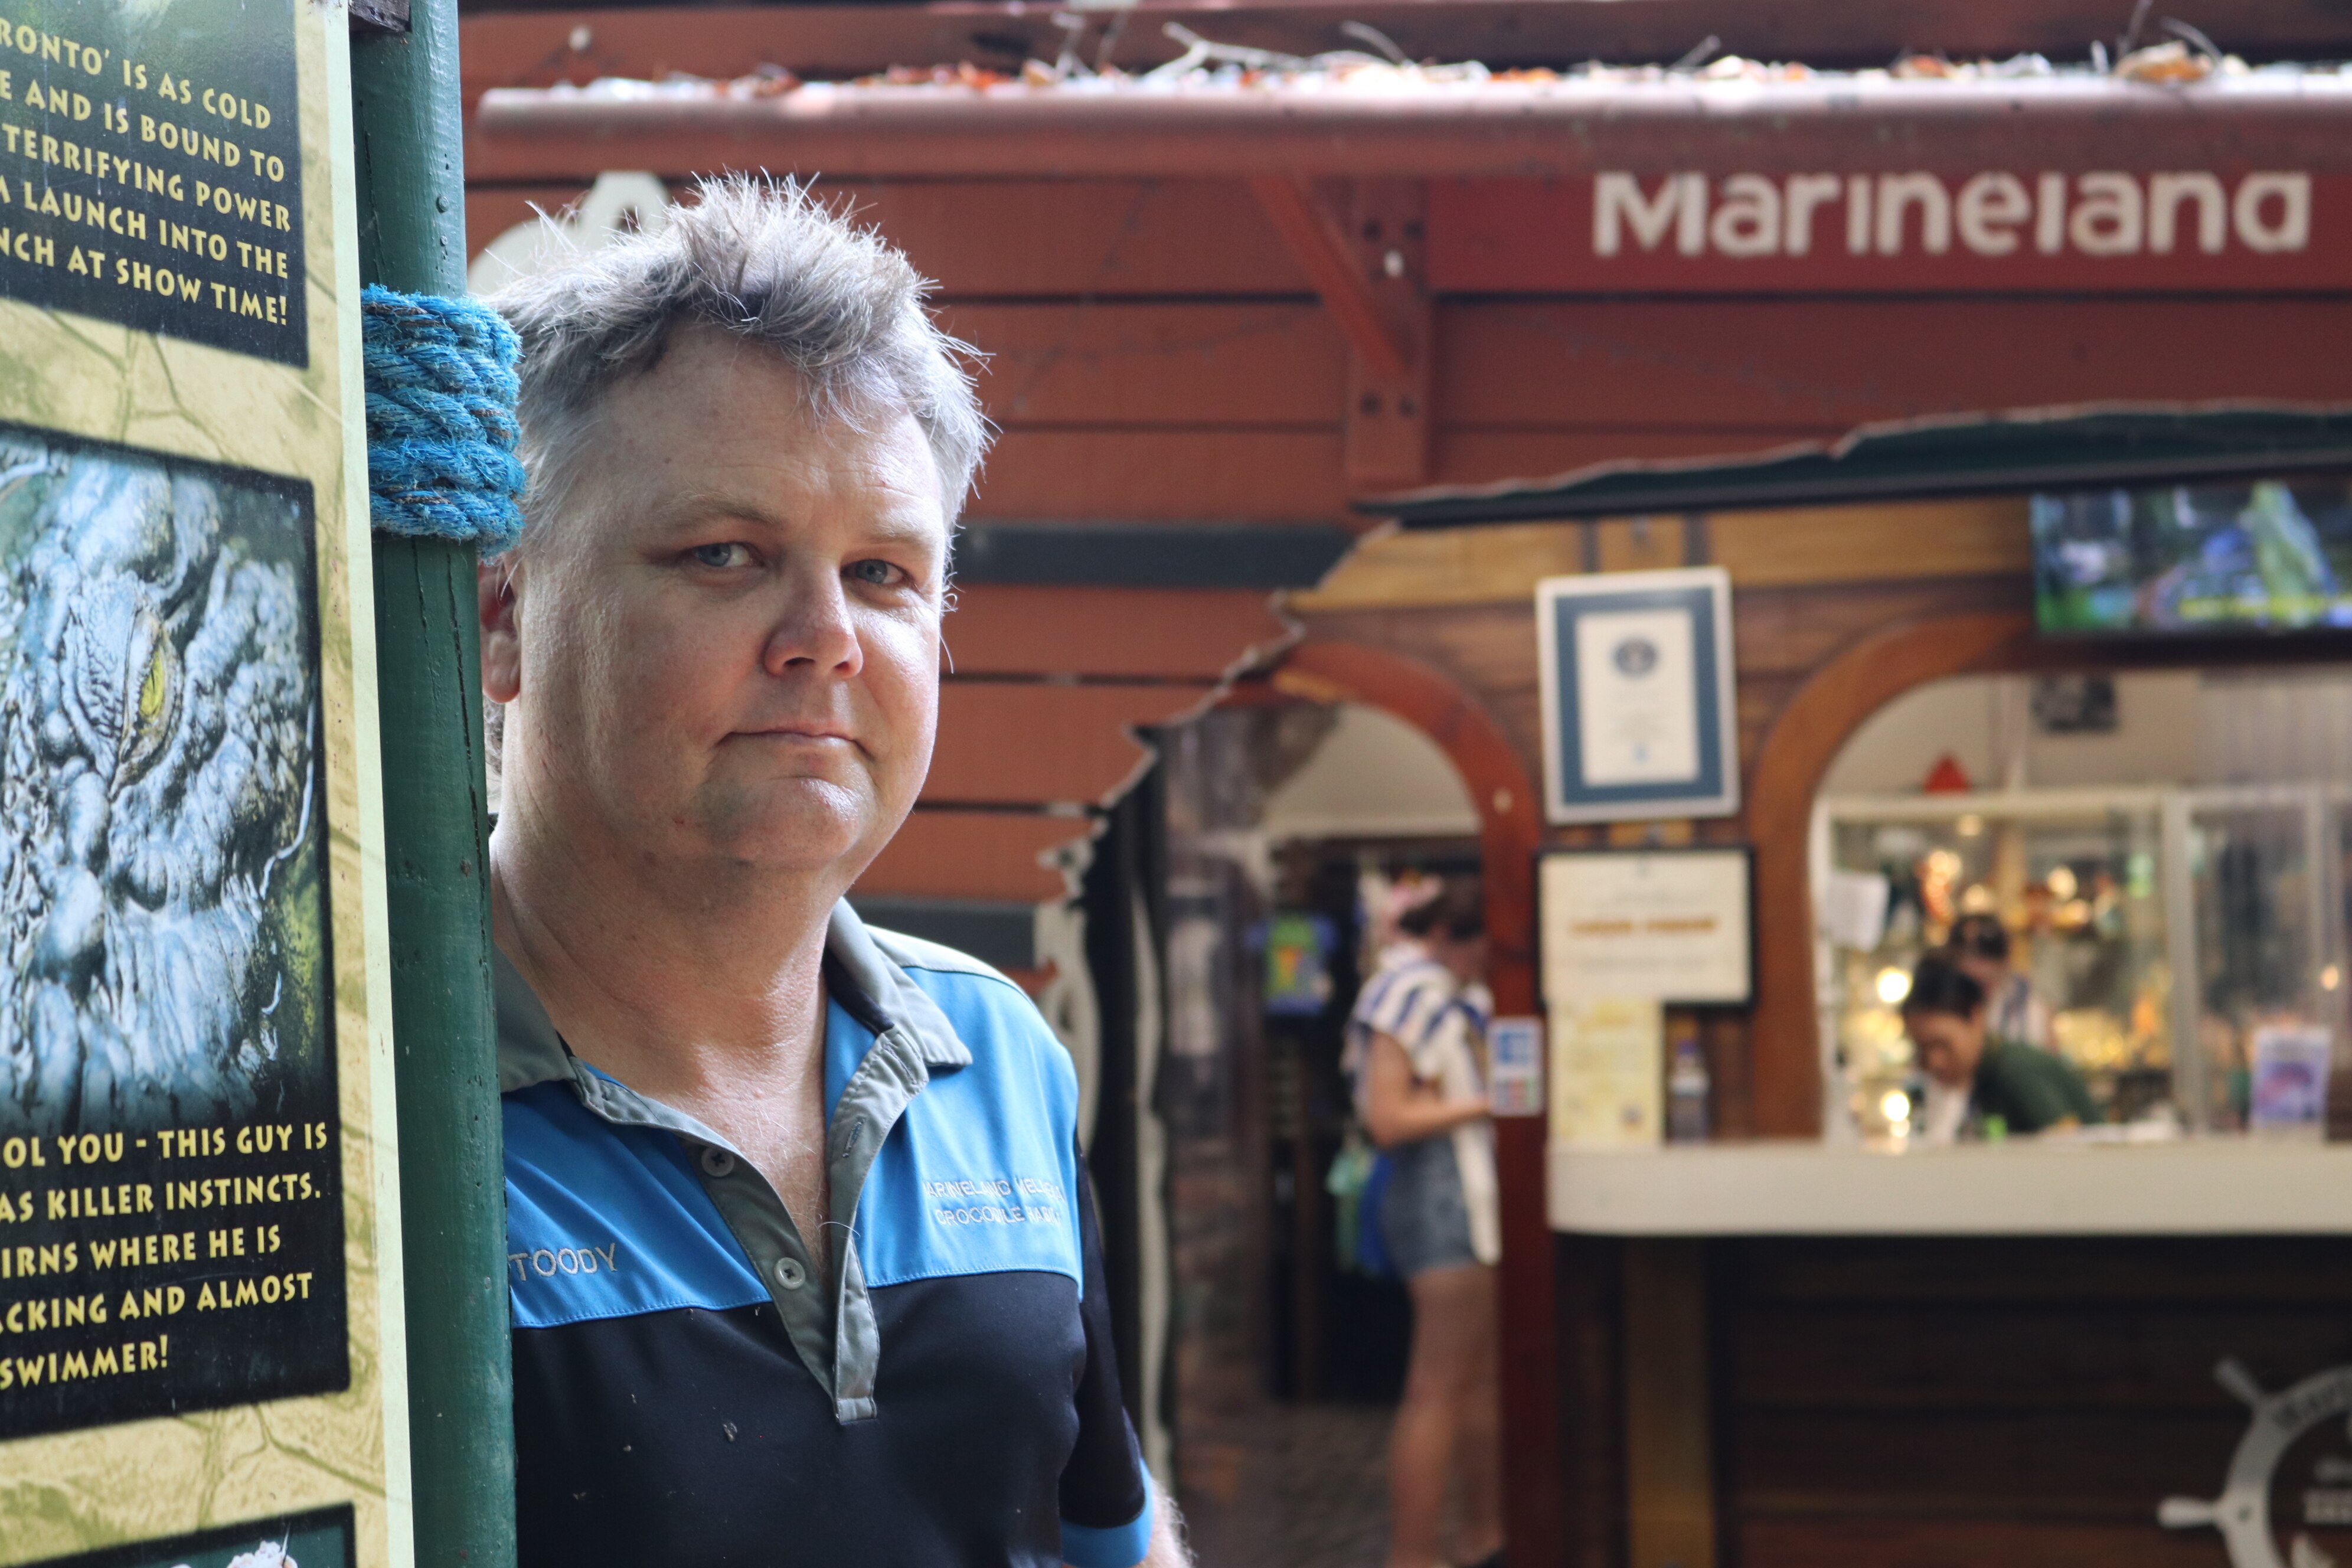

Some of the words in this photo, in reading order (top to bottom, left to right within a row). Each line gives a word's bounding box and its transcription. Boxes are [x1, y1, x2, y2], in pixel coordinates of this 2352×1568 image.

[123, 59, 147, 90] IS
[158, 73, 191, 104] AS
[202, 88, 270, 129] COLD
[25, 79, 91, 121] AND
[104, 103, 129, 134] IS
[141, 115, 240, 167] BOUND
[250, 149, 284, 182] TO
[2, 123, 184, 201] TERRIFYING
[196, 180, 291, 233] POWER
[24, 181, 146, 240] LAUNCH
[159, 219, 227, 261] INTO
[237, 241, 288, 279] THE
[67, 245, 105, 279] AT
[116, 258, 201, 303] SHOW
[210, 282, 286, 325] TIME!
[3, 1137, 45, 1168] OL
[57, 1132, 123, 1165] YOU
[136, 1139, 146, 1148] -
[158, 1127, 226, 1158] THIS
[237, 1124, 292, 1154] GUY
[305, 1122, 327, 1149] IS
[47, 1183, 154, 1220] KILLER
[166, 1172, 321, 1210] INSTINCTS.
[2, 1242, 78, 1279] IRNS
[90, 1231, 196, 1270] WHERE
[209, 1227, 245, 1258] HE
[257, 1224, 280, 1253] IS
[508, 1243, 618, 1282] TOODY
[0, 1293, 107, 1334] CKING
[119, 1286, 185, 1321] AND
[197, 1272, 312, 1312] ALMOST
[0, 1334, 168, 1390] SWIMMER!
